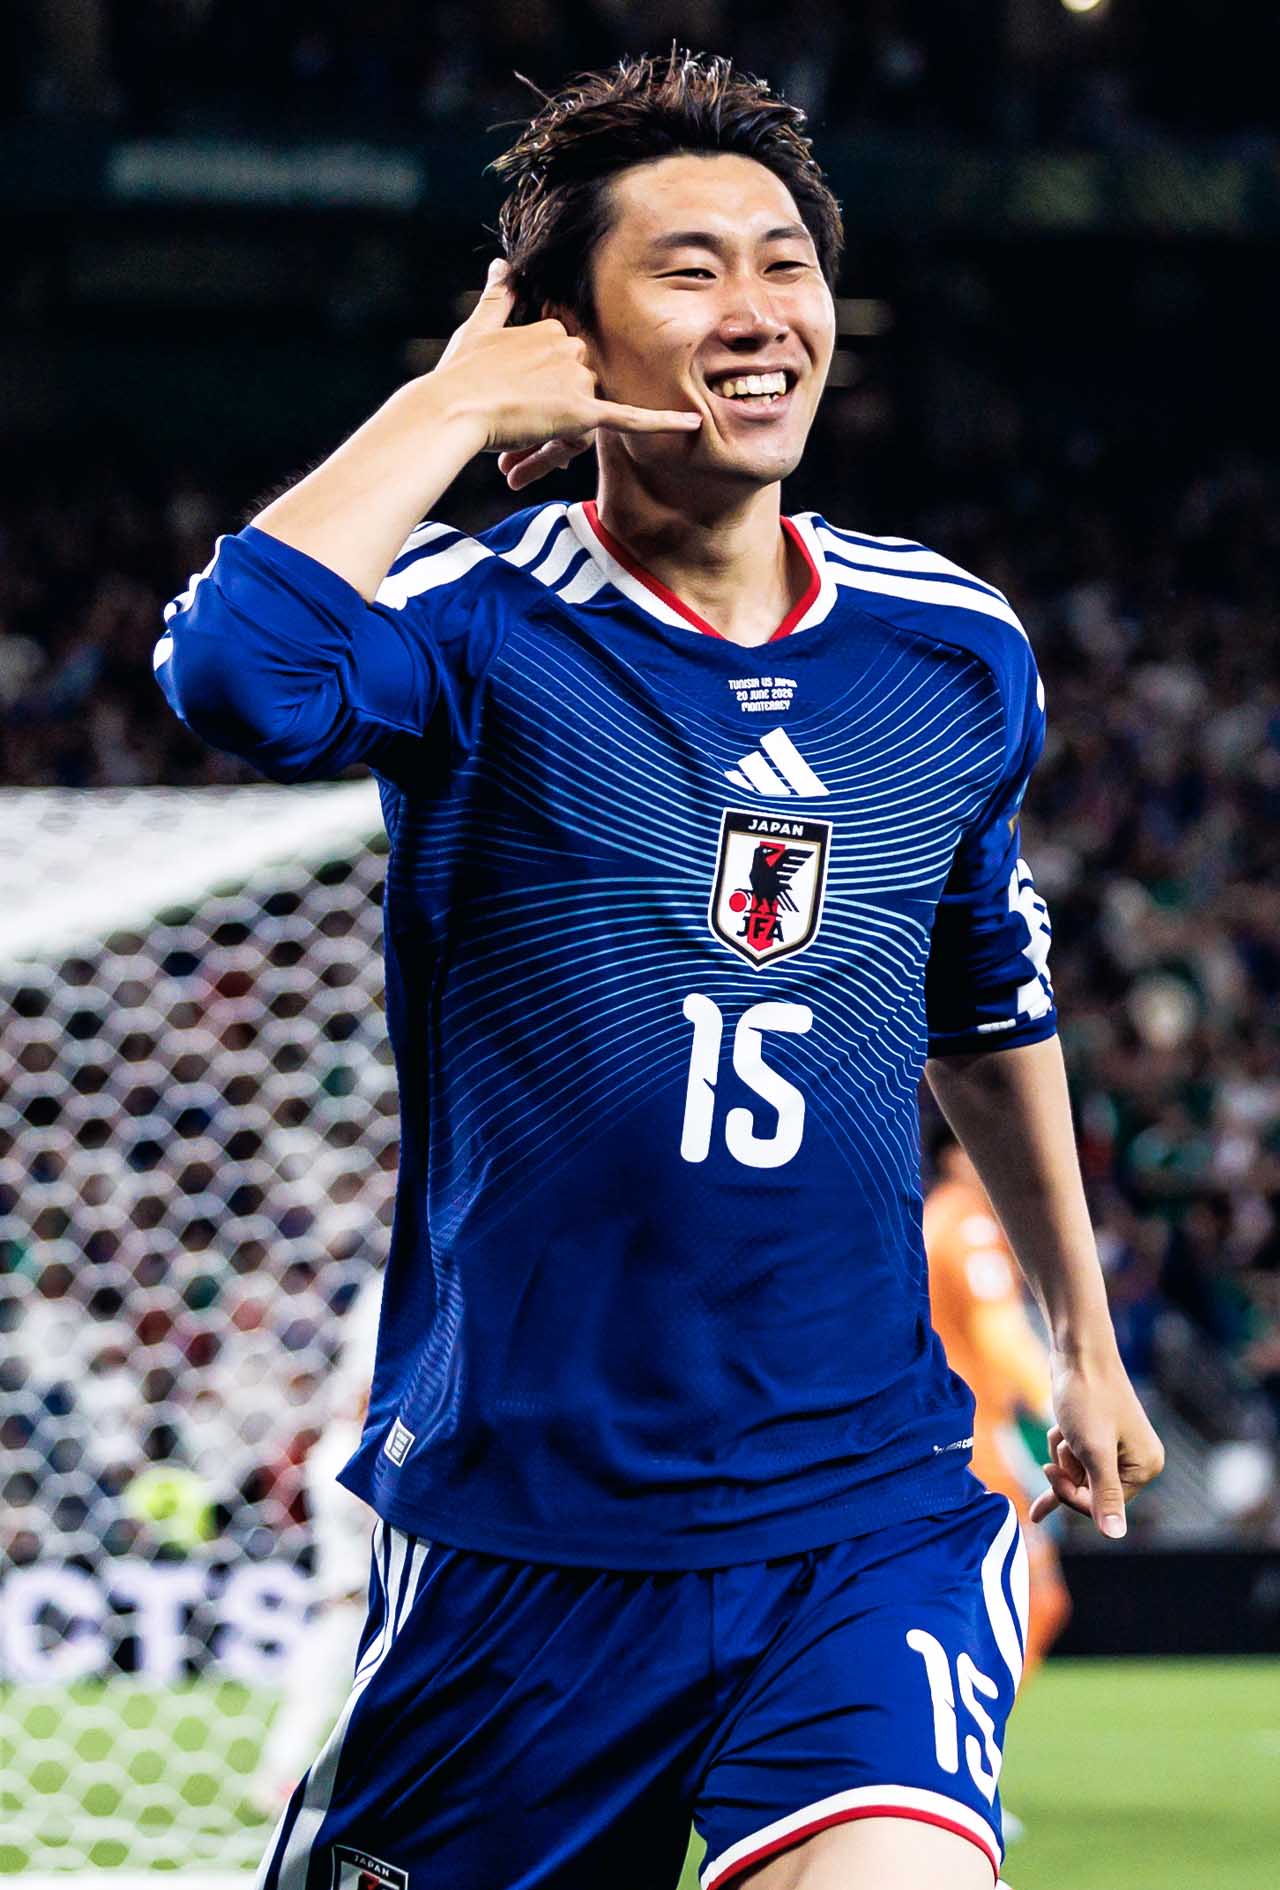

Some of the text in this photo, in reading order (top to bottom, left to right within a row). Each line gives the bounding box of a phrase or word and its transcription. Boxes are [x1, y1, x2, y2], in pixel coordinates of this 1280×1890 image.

[736, 688, 794, 701] 20 JUNE 2026
[748, 819, 804, 836] JAPAN
[736, 915, 784, 942] JFA
[680, 993, 813, 1168] 15
[906, 1629, 1002, 1808] 15
[354, 1855, 390, 1877] JAPAN
